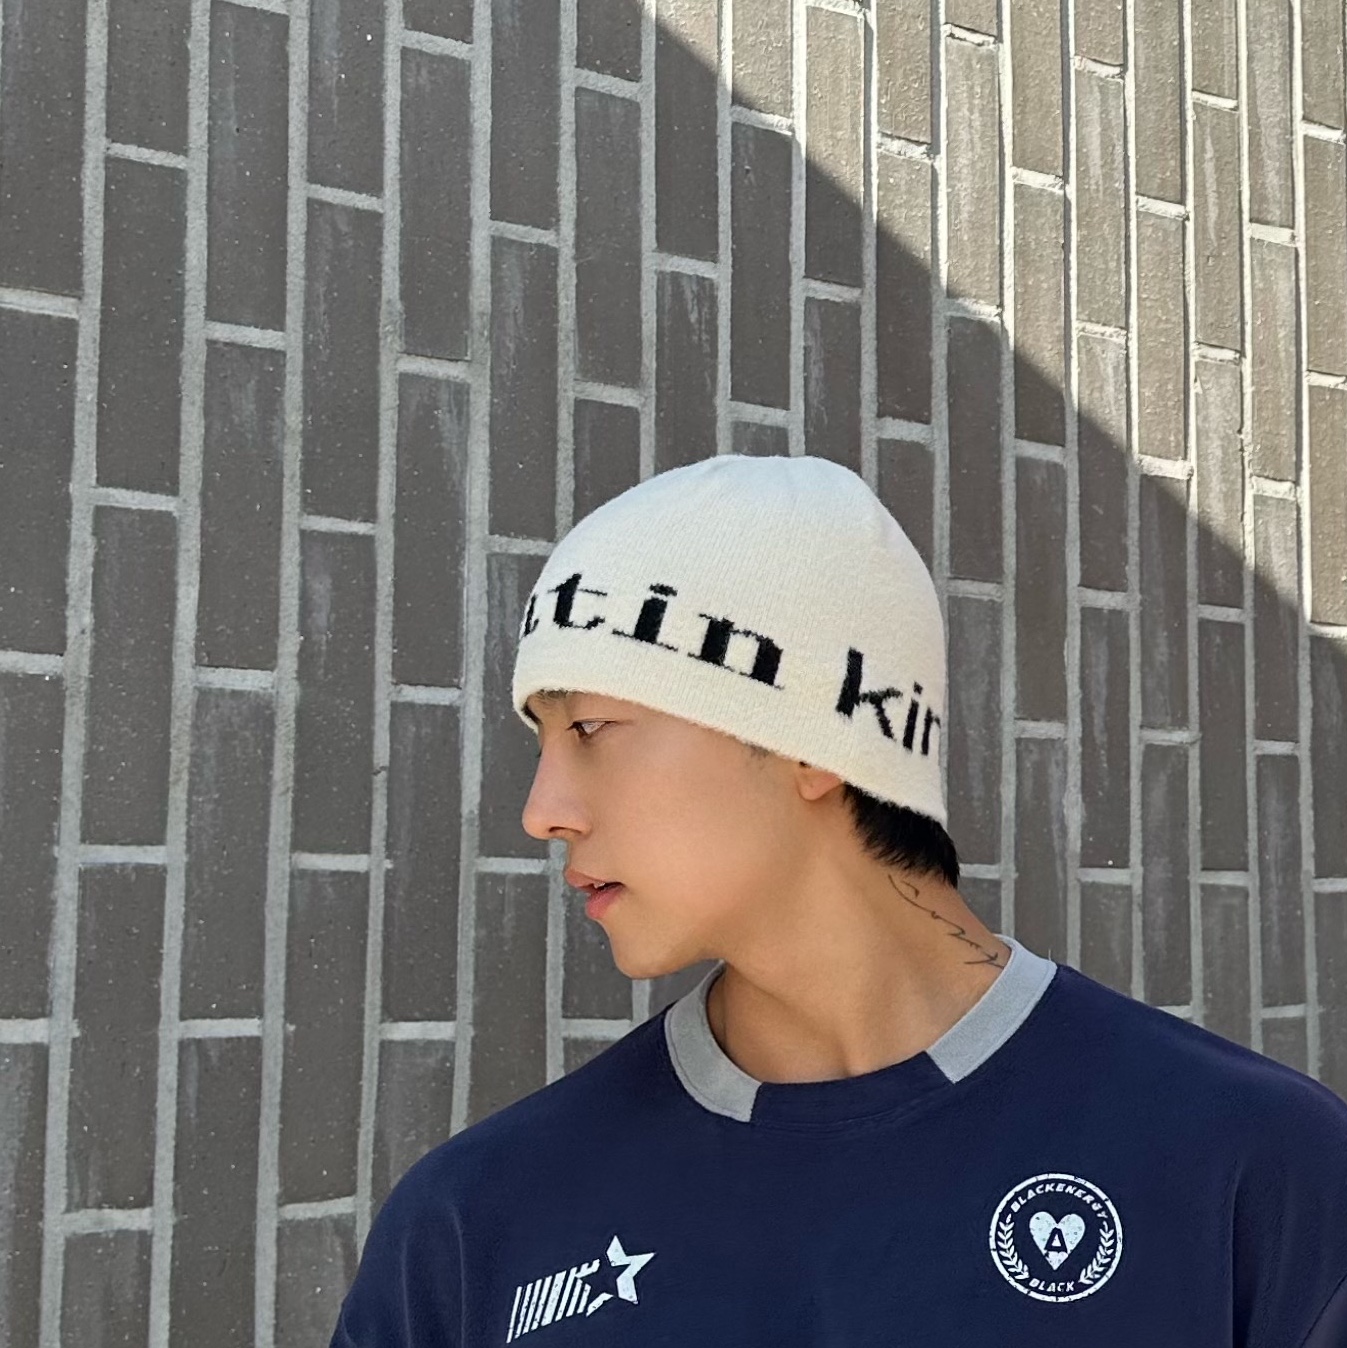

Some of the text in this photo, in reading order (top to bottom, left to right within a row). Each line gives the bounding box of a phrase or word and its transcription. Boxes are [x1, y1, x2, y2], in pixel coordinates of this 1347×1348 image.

[1010, 1182, 1108, 1219] BLACKENERGY
[1044, 1226, 1068, 1253] A
[1029, 1277, 1075, 1293] BLACK
